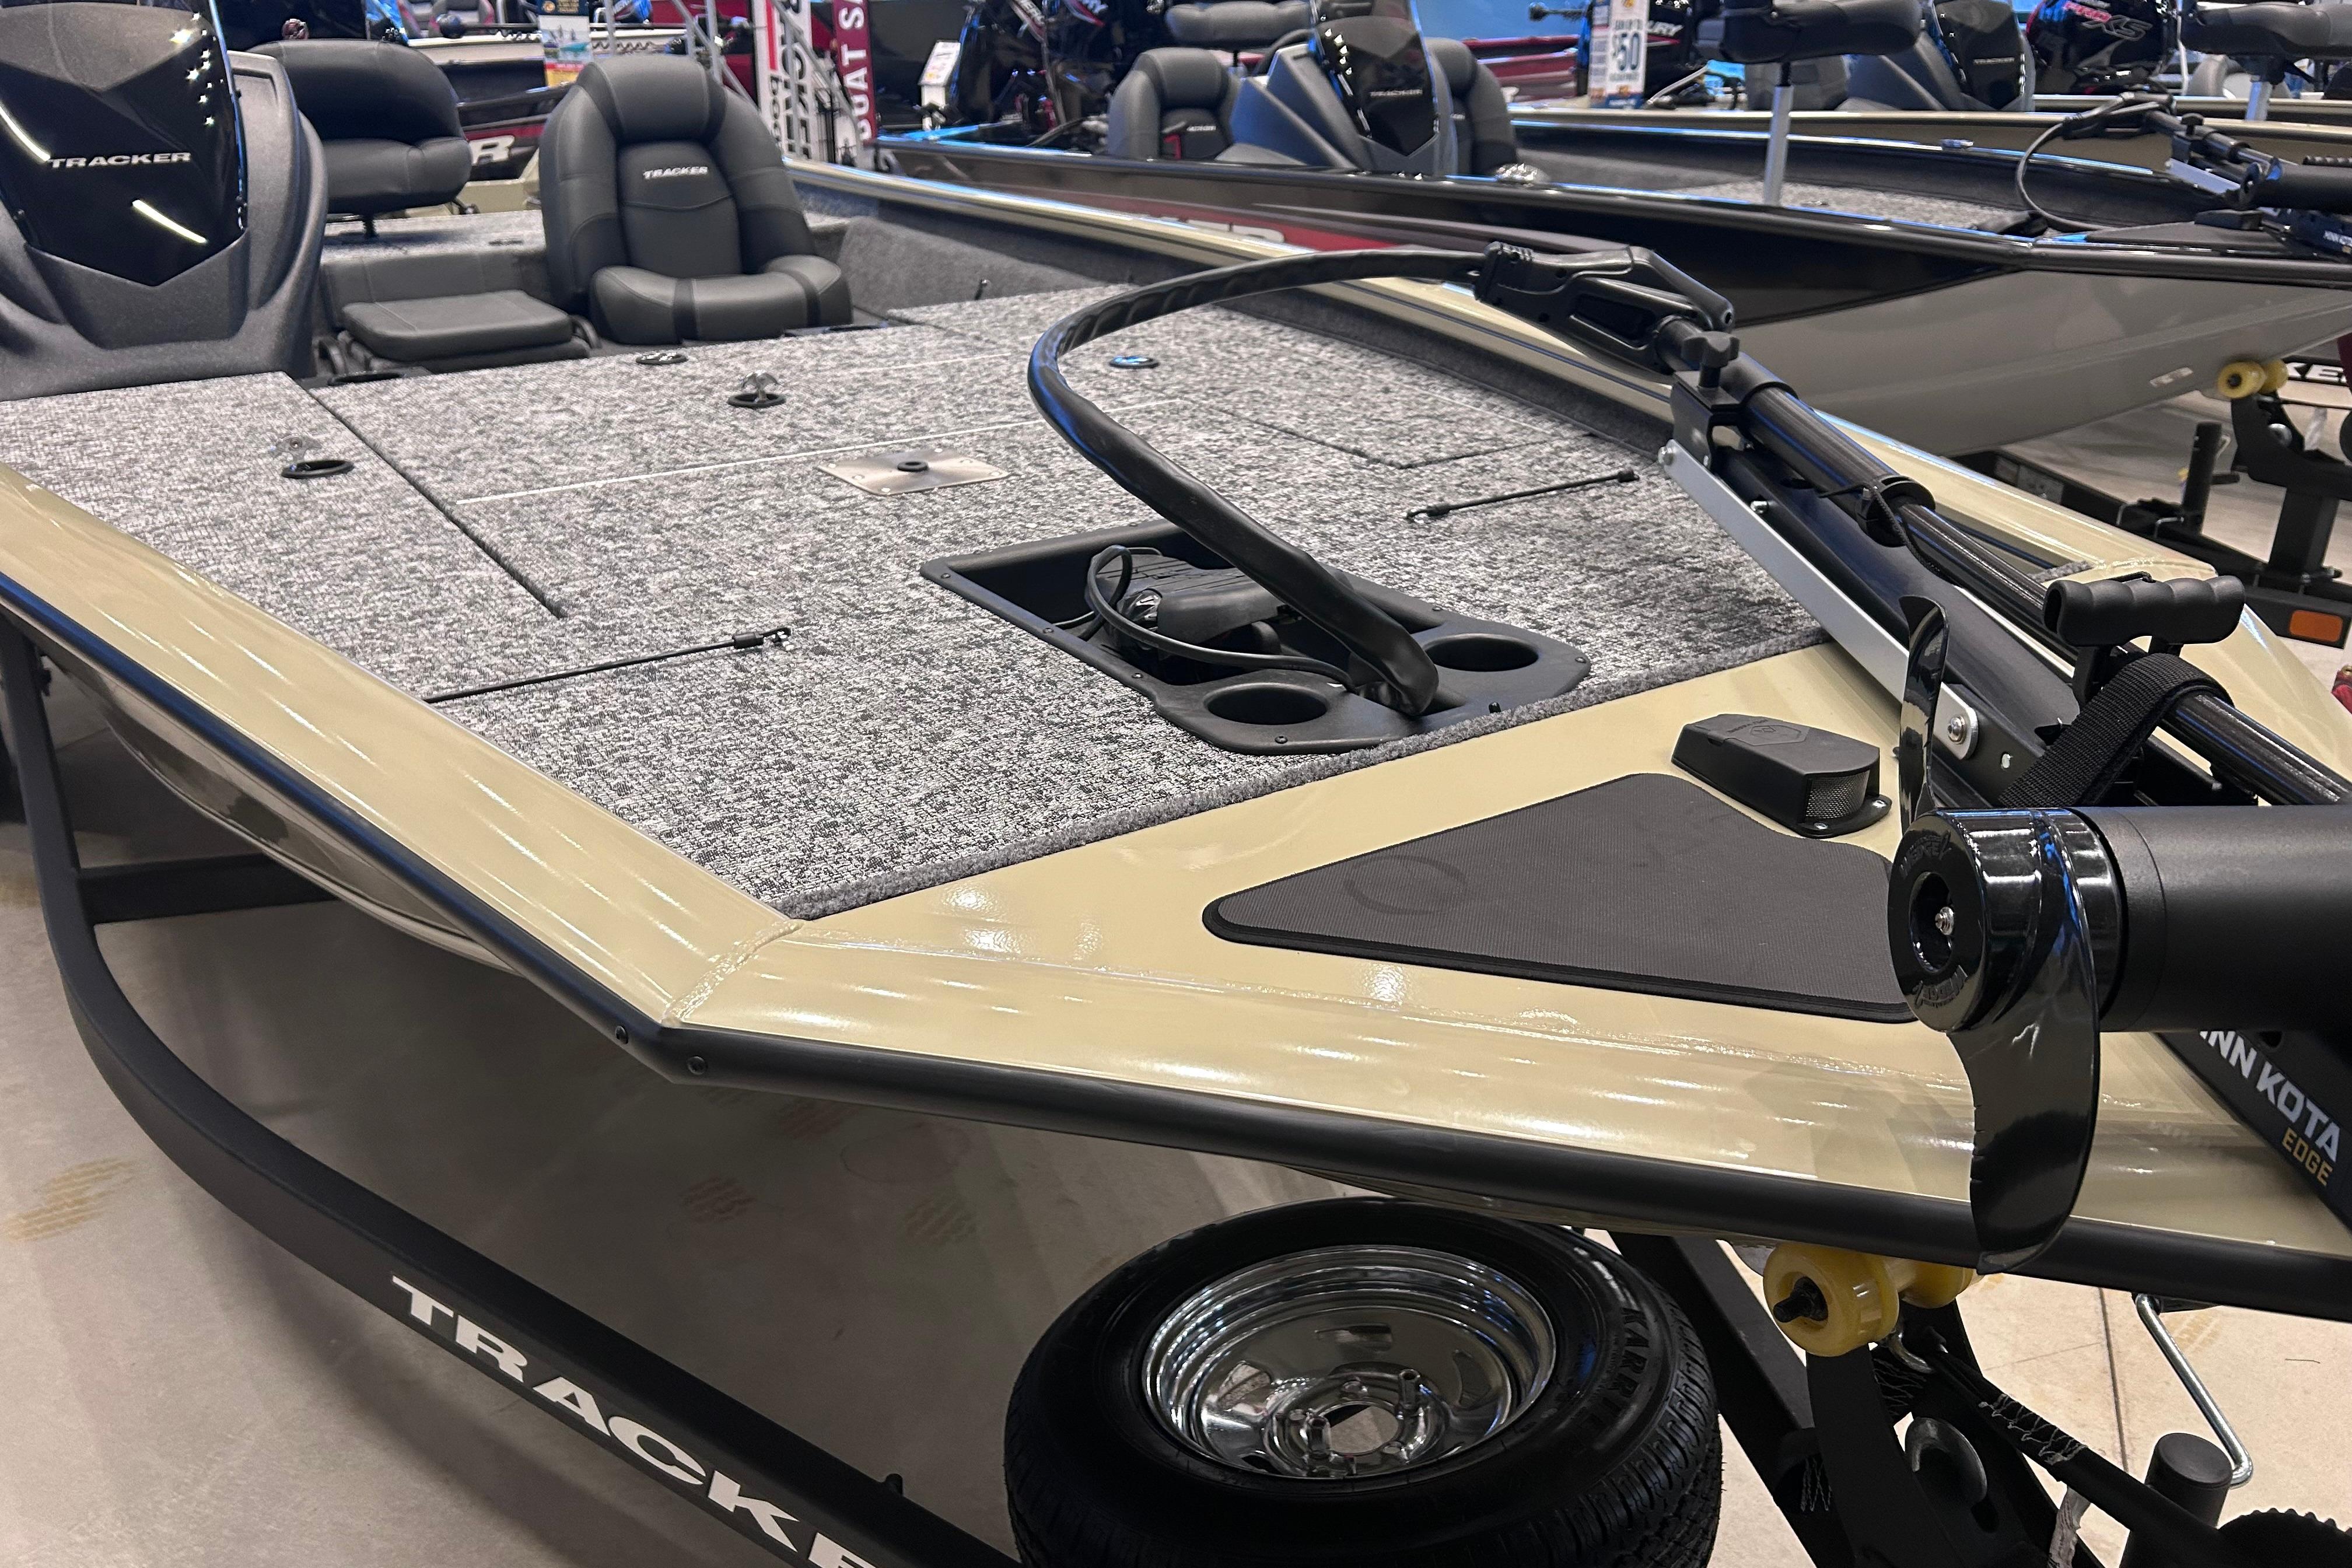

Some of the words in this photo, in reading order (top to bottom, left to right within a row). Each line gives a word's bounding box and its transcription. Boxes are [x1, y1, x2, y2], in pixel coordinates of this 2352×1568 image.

[48, 152, 191, 169] TRACKER
[643, 166, 708, 180] TRACKER
[2256, 1060, 2340, 1163] KOTA
[2281, 1126, 2333, 1186] EDGE
